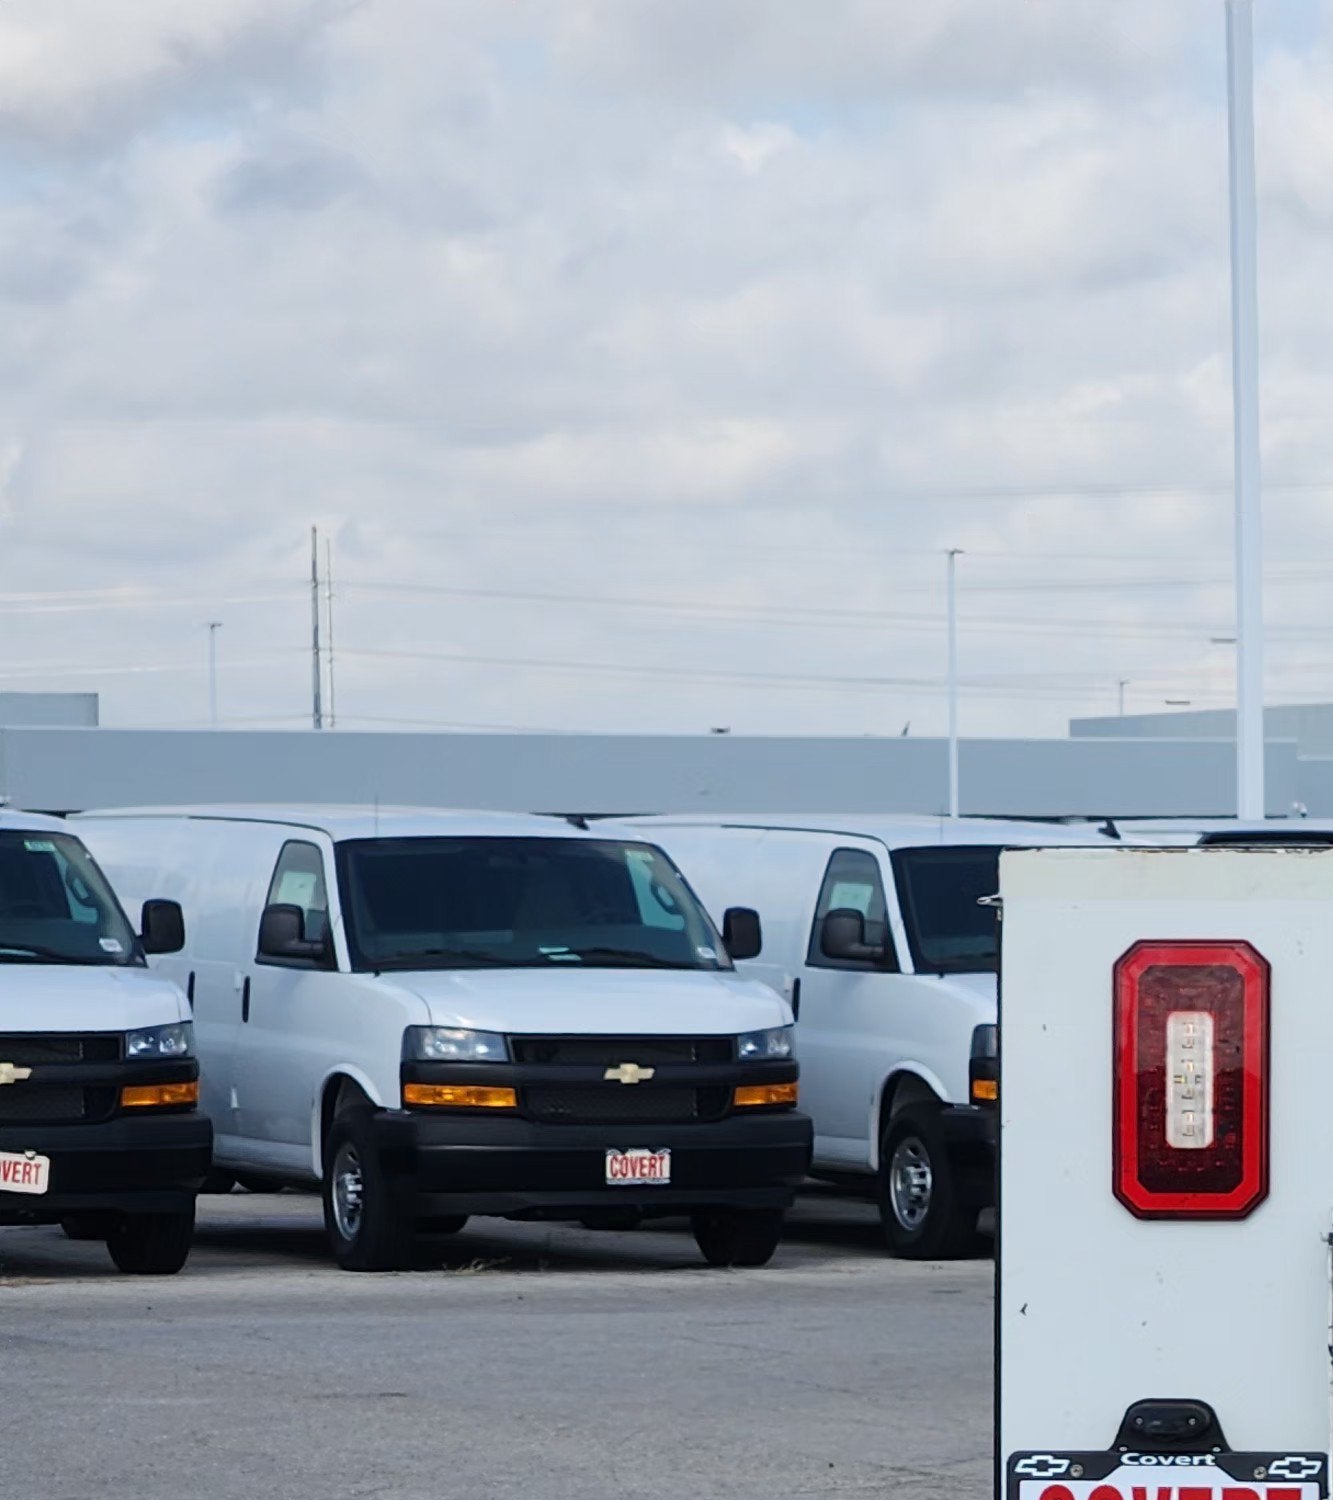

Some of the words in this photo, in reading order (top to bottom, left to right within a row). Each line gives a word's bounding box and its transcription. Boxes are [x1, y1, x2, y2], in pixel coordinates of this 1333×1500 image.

[0, 1160, 42, 1185] VERT
[610, 1154, 664, 1178] COVERT
[1120, 1453, 1216, 1467] Covert
